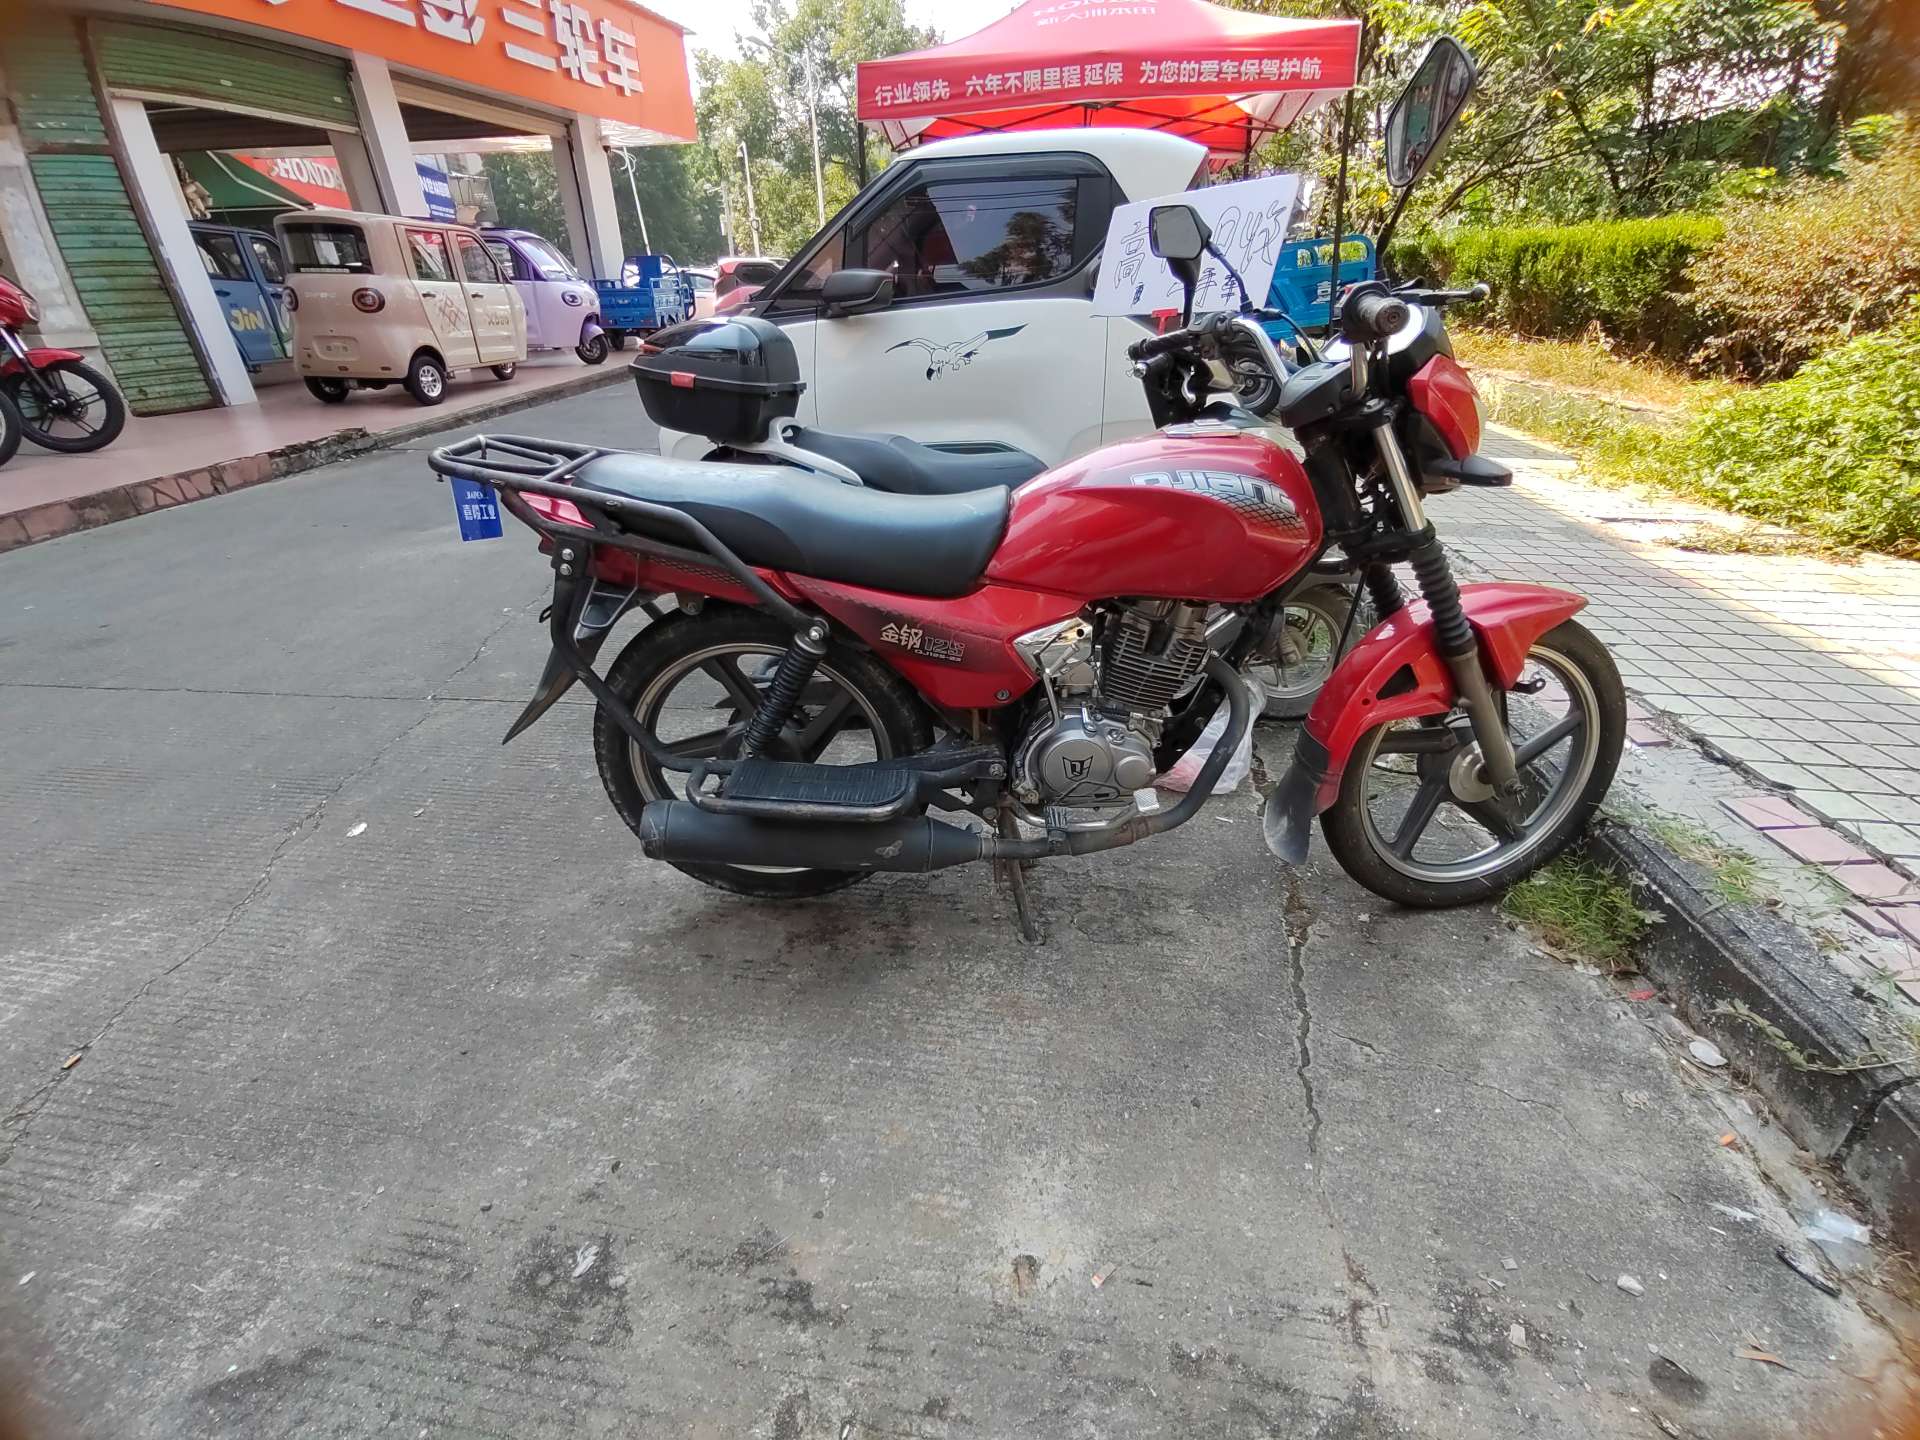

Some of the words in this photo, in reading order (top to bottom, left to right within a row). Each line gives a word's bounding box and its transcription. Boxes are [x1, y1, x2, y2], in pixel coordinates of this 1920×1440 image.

[874, 84, 951, 108] 行业领先
[965, 61, 1124, 97] 六年不限里程延保
[1138, 56, 1322, 84] 为您的爱车保驾护航
[1113, 199, 1287, 289] 高回收
[880, 622, 923, 650] 金钢
